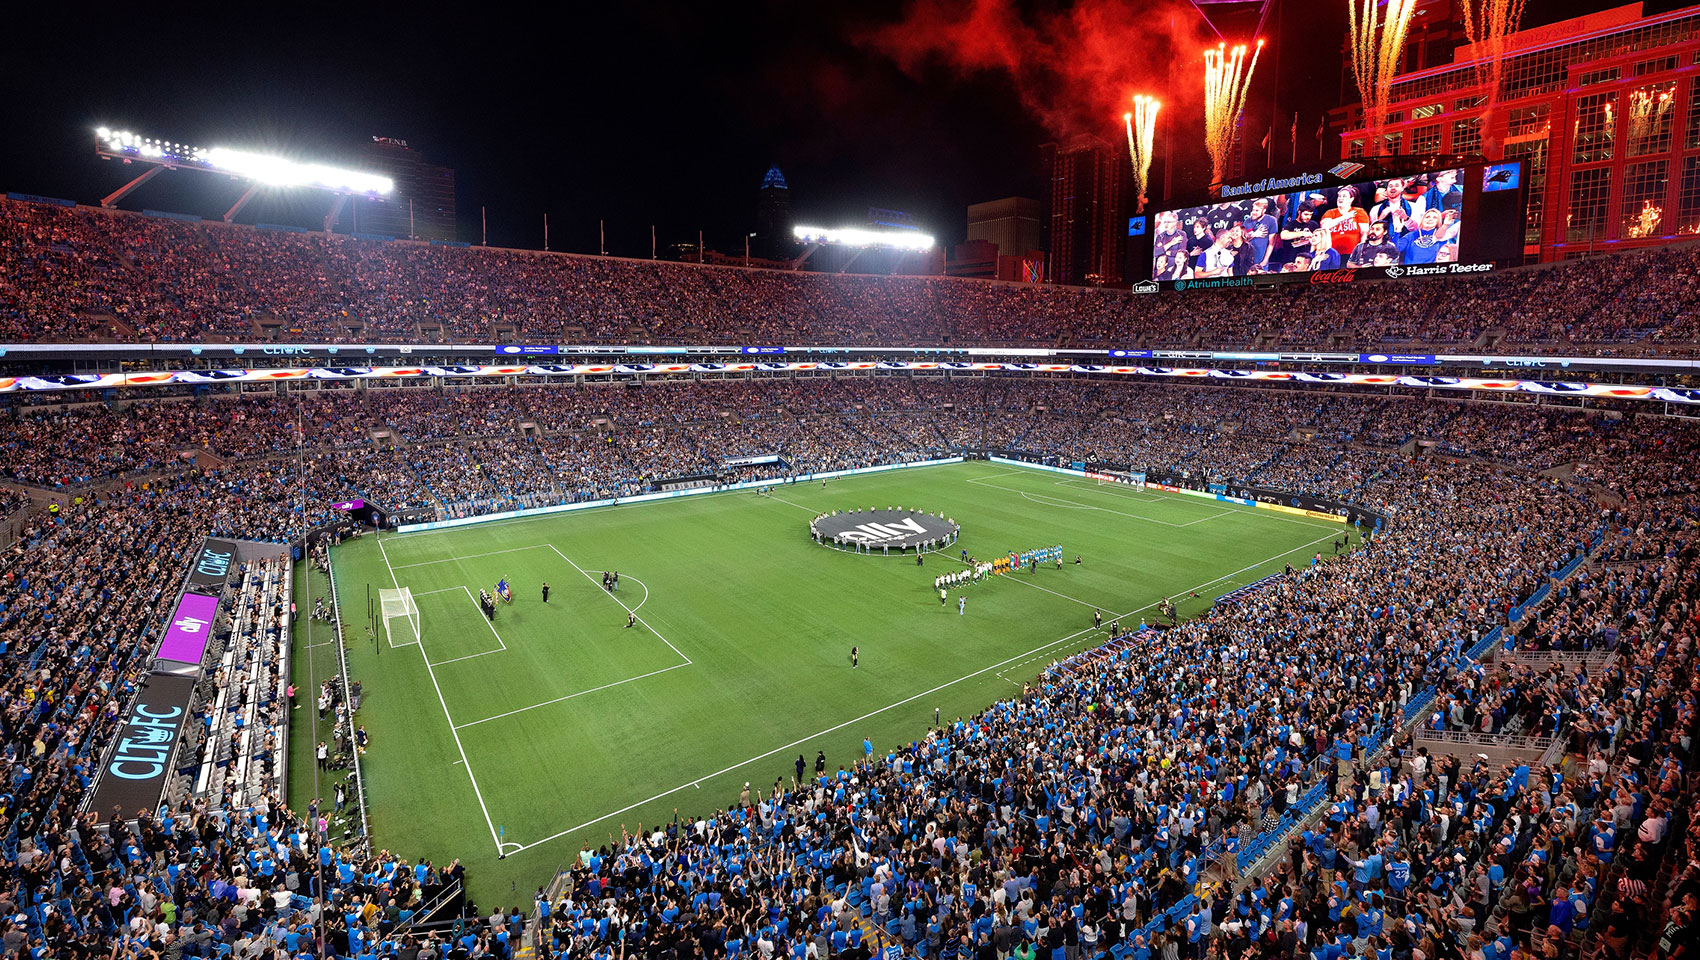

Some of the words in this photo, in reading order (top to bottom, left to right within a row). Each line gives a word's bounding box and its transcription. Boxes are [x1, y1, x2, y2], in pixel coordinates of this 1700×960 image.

[1221, 182, 1254, 198] Bank
[1253, 179, 1267, 193] of
[1267, 172, 1323, 191] America
[1213, 218, 1230, 230] ally
[1406, 265, 1447, 276] Harris
[1450, 262, 1493, 273] Teeter
[1187, 279, 1221, 289] Atrium
[1221, 276, 1254, 287] Health
[838, 517, 928, 541] ally
[174, 616, 209, 633] ally
